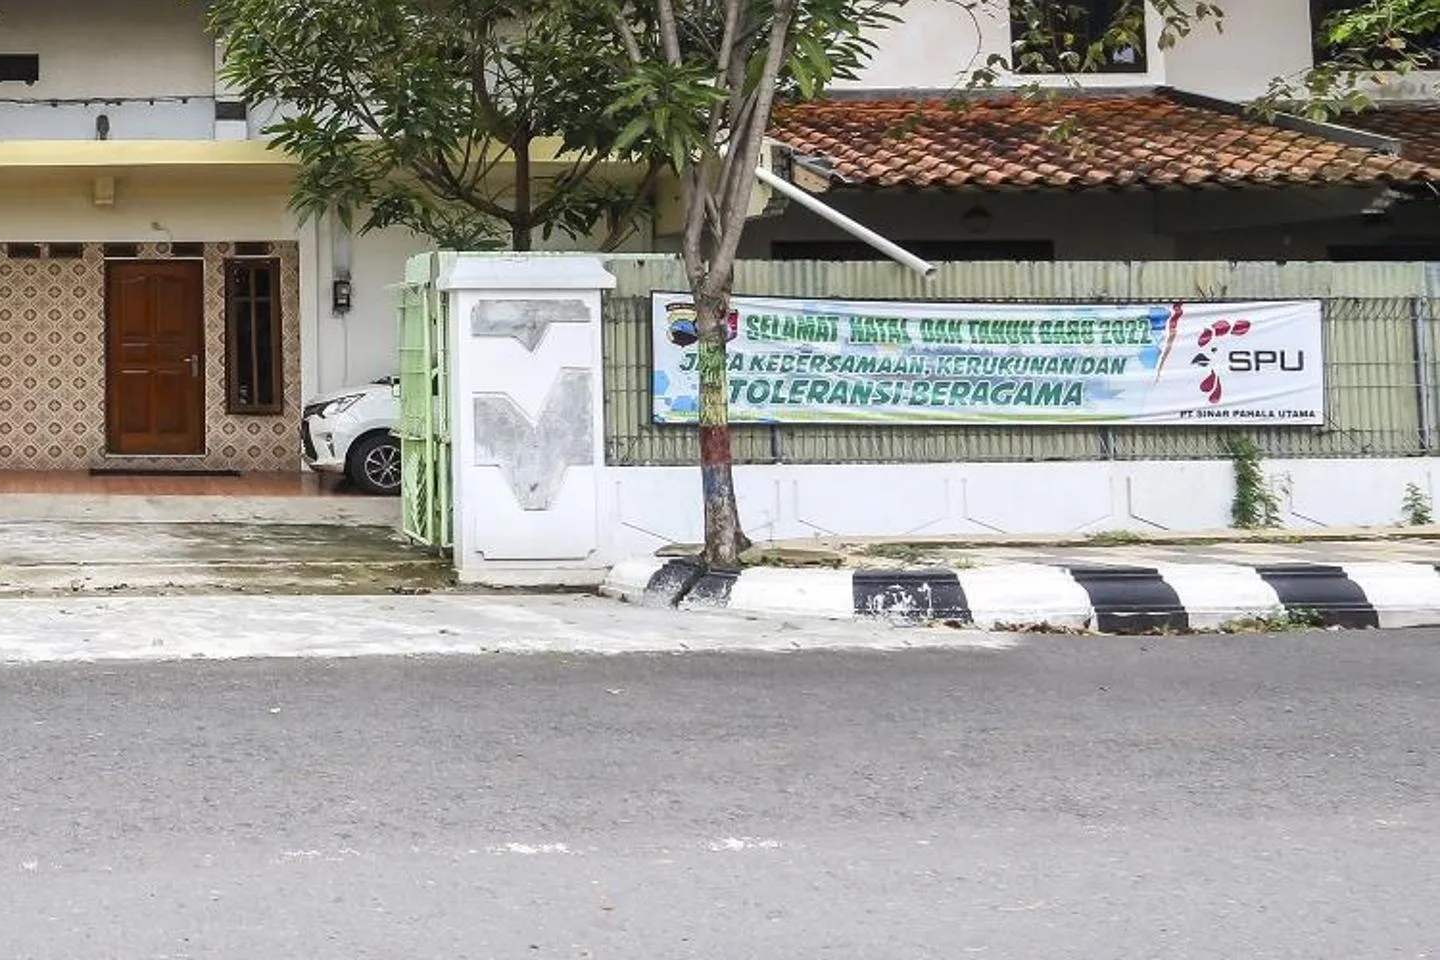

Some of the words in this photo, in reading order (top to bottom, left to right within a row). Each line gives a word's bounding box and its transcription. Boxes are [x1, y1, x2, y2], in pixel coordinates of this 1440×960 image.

[746, 315, 839, 341] SELAMAT
[968, 320, 1034, 344] TAHUN
[936, 356, 1075, 375] KERUKUNAN
[1079, 357, 1127, 375] DAN
[1229, 350, 1304, 371] SPU
[729, 379, 903, 404] TOLERANSI
[910, 381, 1084, 406] BERAGAMA
[1196, 409, 1230, 418] SINAR
[1233, 409, 1275, 418] PAHALA
[1278, 410, 1316, 418] UTAMA
